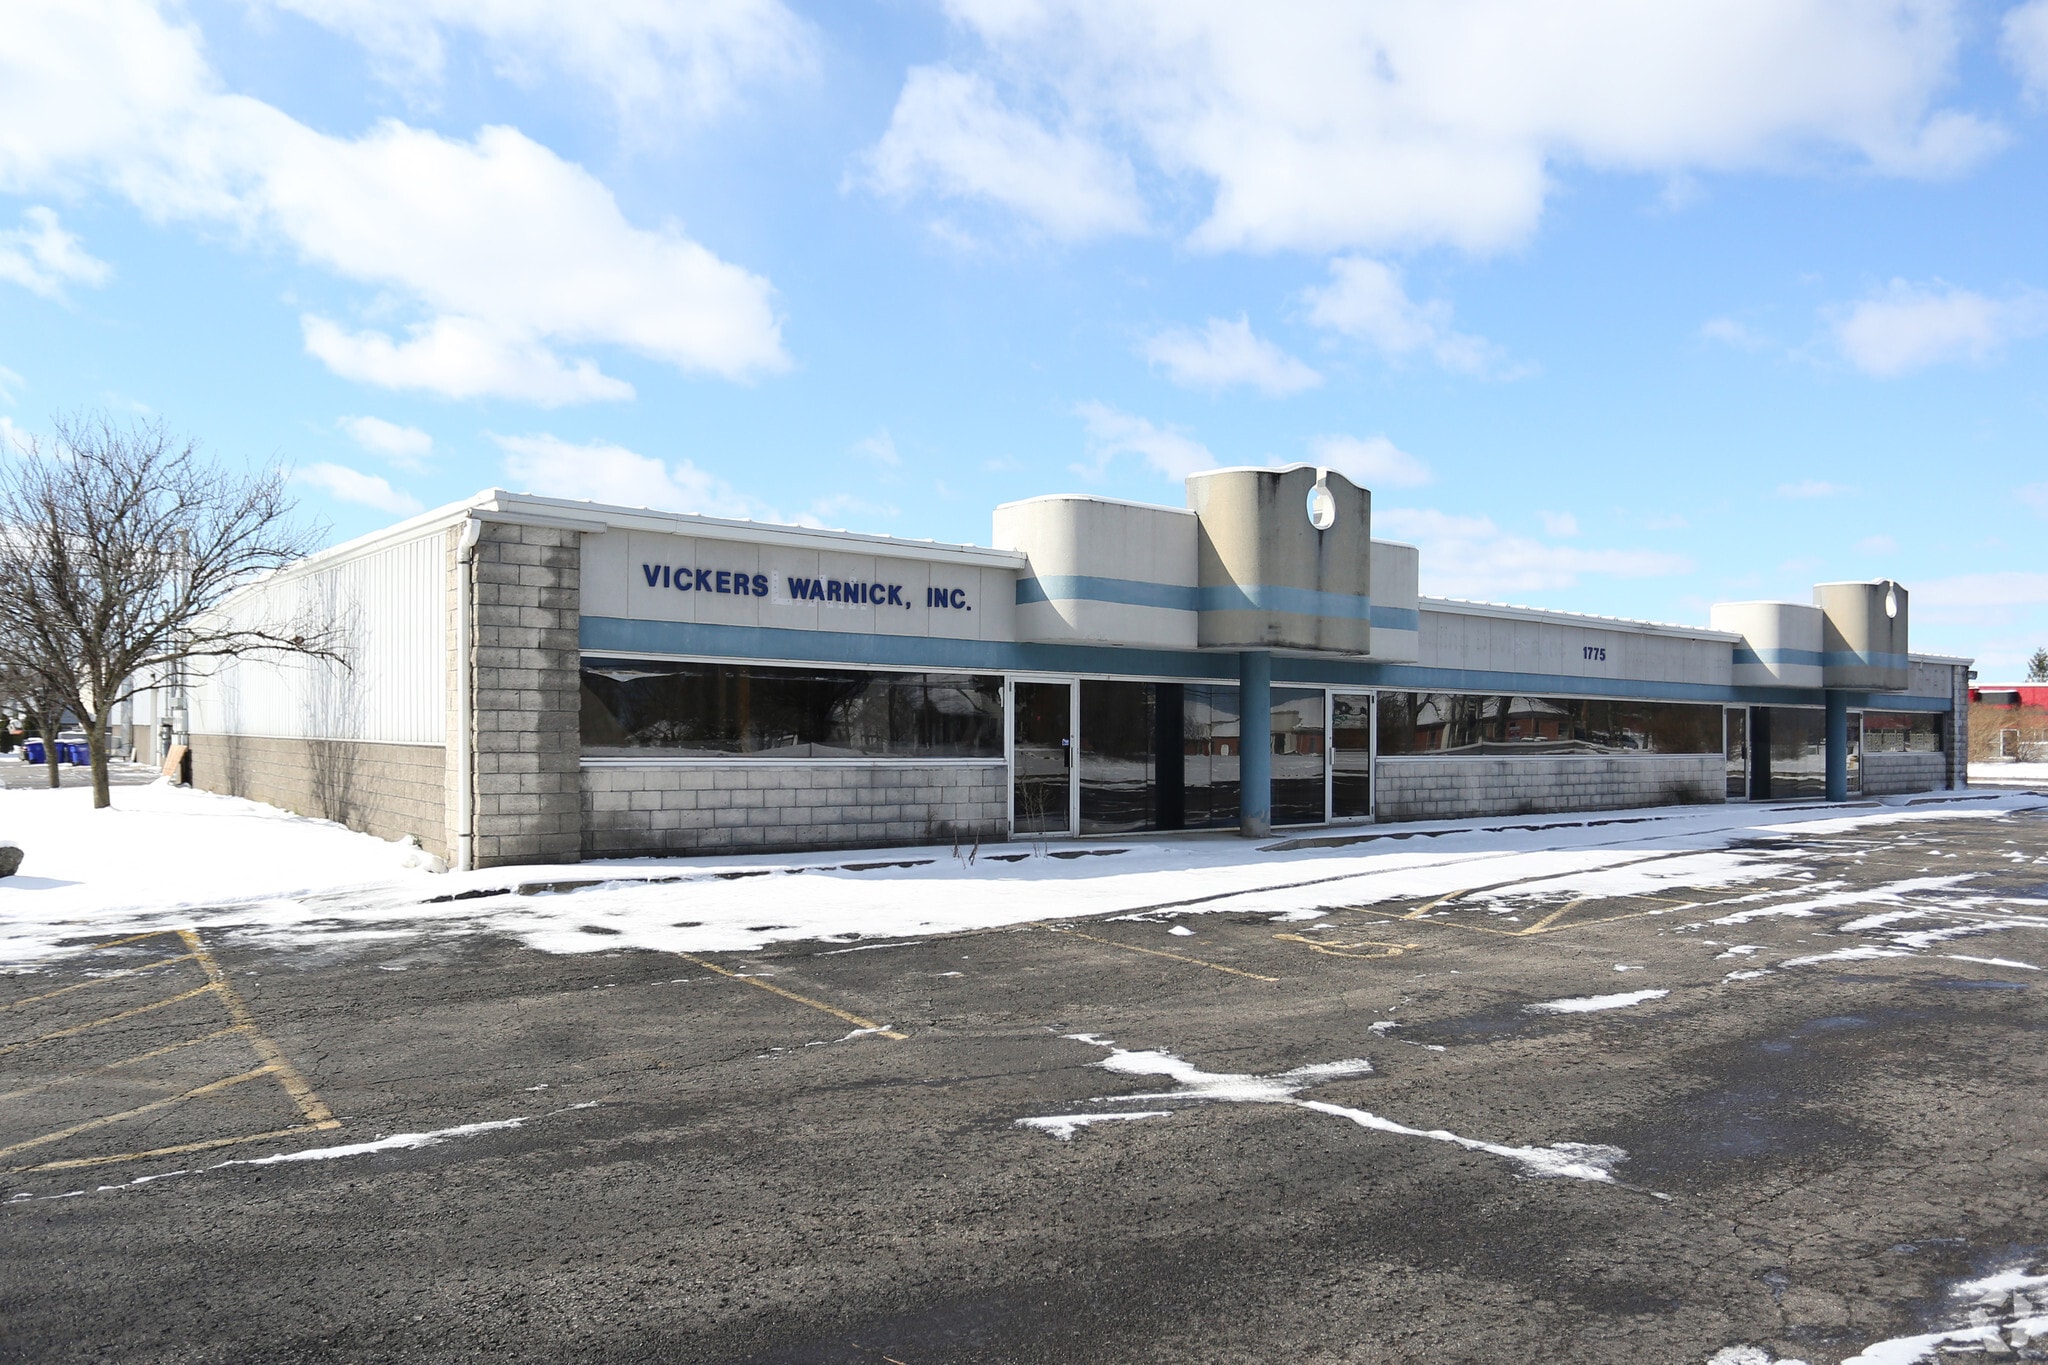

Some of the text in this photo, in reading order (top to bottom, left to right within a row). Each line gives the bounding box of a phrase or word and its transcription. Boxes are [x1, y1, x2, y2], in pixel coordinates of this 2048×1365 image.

[642, 564, 972, 611] VICKERS WARNICK, INC.
[1582, 646, 1606, 661] 1775
